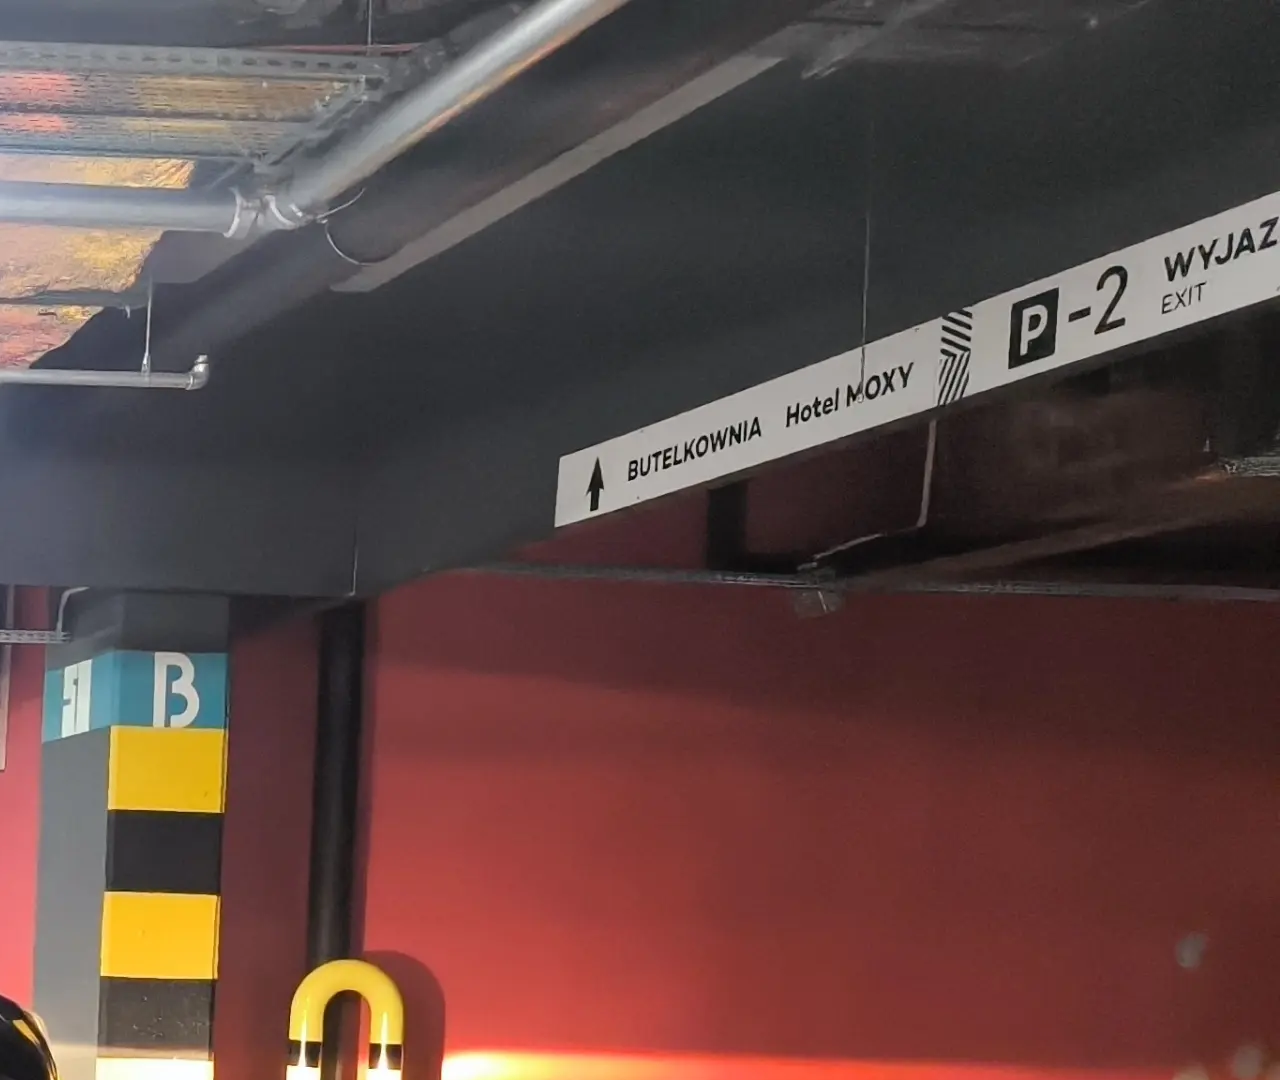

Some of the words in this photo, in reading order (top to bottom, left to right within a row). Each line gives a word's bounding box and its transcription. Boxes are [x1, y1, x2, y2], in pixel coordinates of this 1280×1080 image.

[1019, 304, 1049, 356] P
[1161, 281, 1207, 314] EXIT
[785, 387, 839, 428] Hotel
[846, 362, 914, 407] MOXY
[627, 416, 762, 482] BUTELKOWNIA
[152, 652, 200, 728] B
